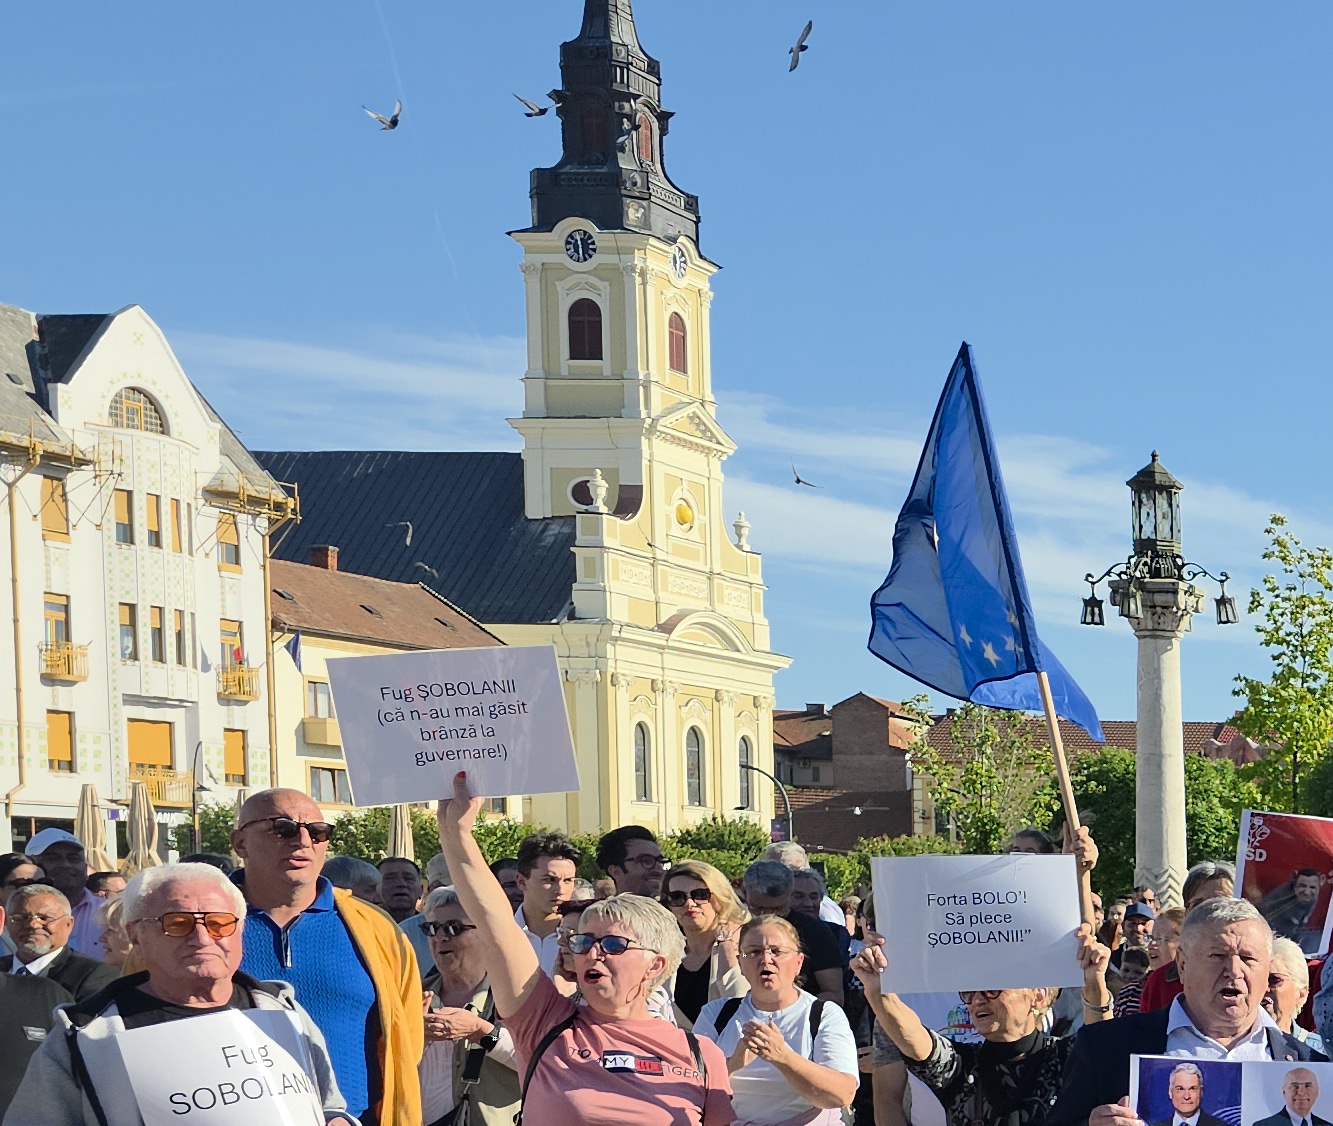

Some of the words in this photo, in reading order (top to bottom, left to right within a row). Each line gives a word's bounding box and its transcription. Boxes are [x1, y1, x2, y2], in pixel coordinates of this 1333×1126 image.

[379, 686, 415, 703] Fug
[377, 707, 405, 727] (că
[409, 707, 451, 721] n-au
[455, 702, 485, 718] mai
[488, 700, 529, 719] găsit
[419, 724, 478, 742] brânză
[480, 724, 496, 739] la
[414, 743, 508, 767] guvernare!)
[927, 892, 968, 907] Forta
[945, 912, 965, 926] Să
[969, 911, 1012, 927] plece
[221, 1044, 275, 1069] Fug
